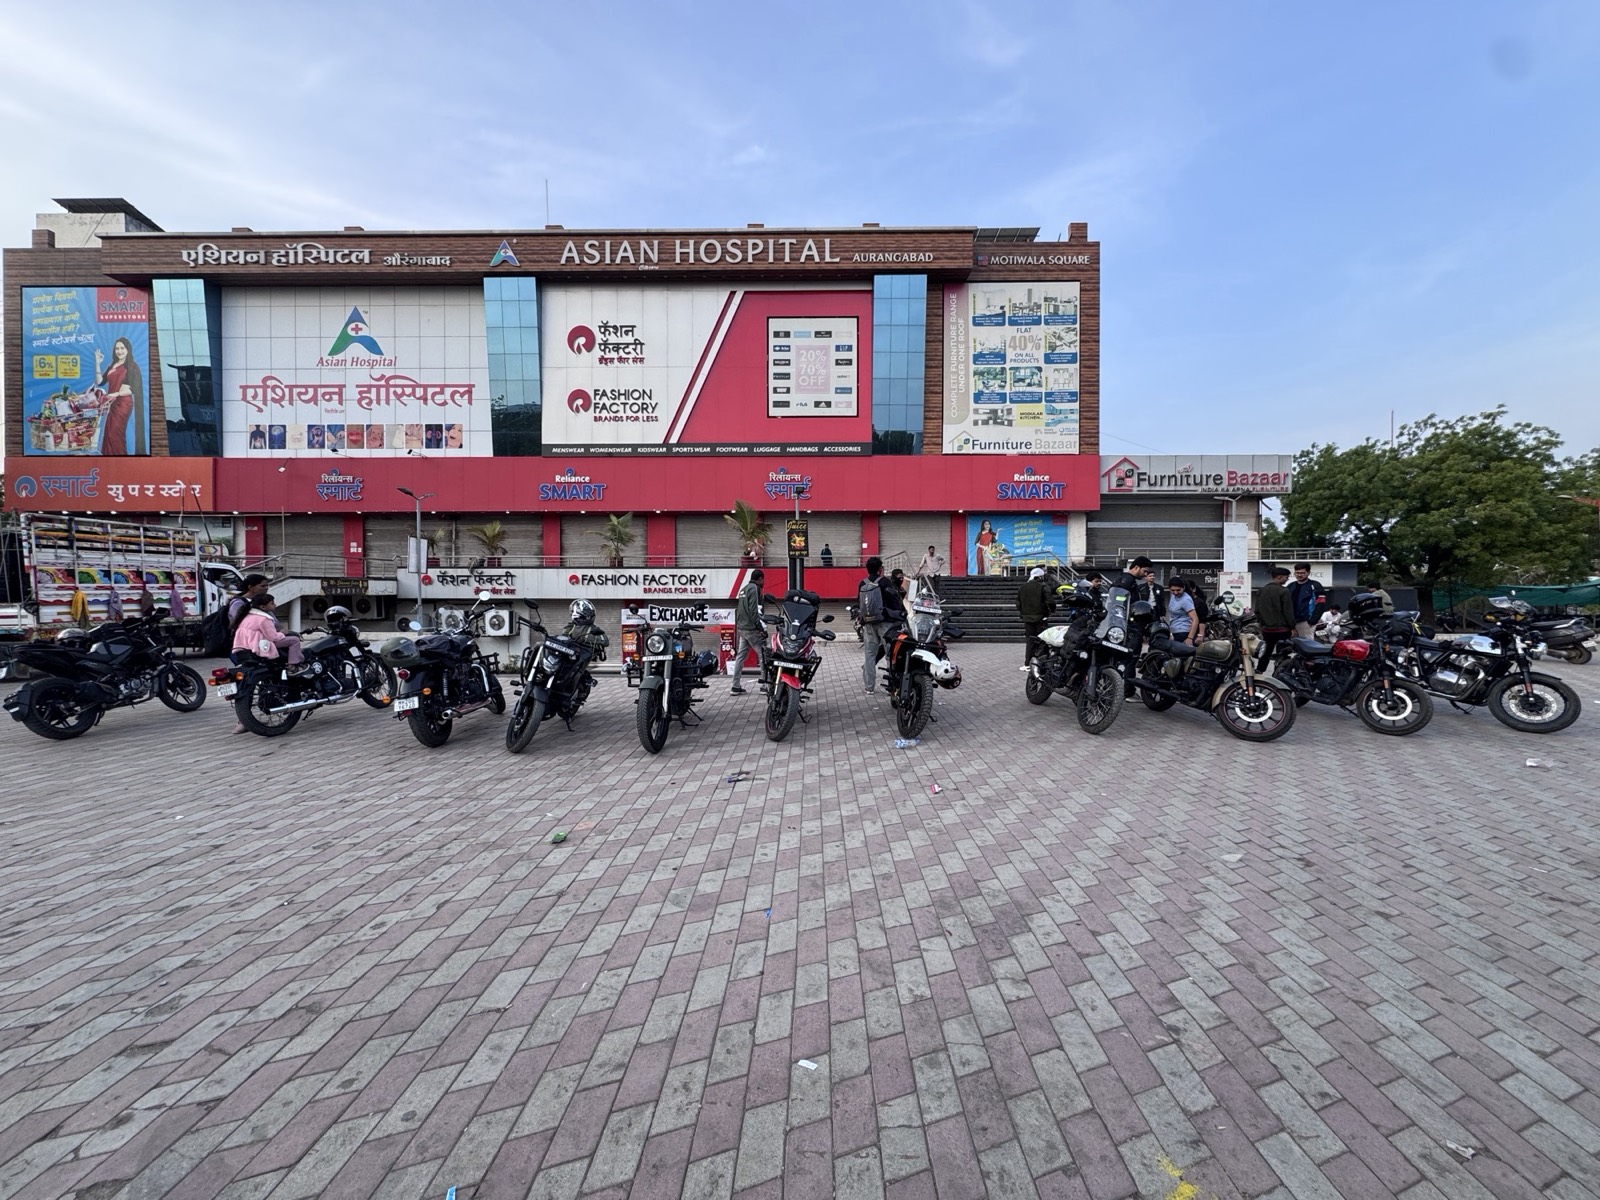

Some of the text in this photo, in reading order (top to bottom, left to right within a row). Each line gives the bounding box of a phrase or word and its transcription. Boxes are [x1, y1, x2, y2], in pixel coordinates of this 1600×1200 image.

[181, 242, 452, 267] एशियन हॉस्पिटल औरंगाबाद
[560, 238, 934, 264] ASIAN HOSPITAL AURANGABAD
[990, 255, 1090, 265] MOTIWALA SQUARE
[100, 301, 145, 313] SMART
[598, 320, 637, 338] फॅशन
[598, 338, 645, 356] फॅक्टरी
[1008, 335, 1041, 351] 40%
[316, 356, 398, 369] Asian Hospital
[799, 350, 826, 362] 20%
[949, 293, 958, 418] COMPLETE FURNITURE RANGE
[799, 364, 826, 376] 70%
[798, 376, 825, 386] OFF
[239, 373, 476, 413] एशियन हॉस्पिटल
[593, 389, 652, 401] FASHION
[593, 402, 658, 414] FACTORY
[971, 438, 1078, 450] Furniture Bazaar
[40, 467, 100, 498] स्मार्ट
[321, 473, 353, 483] रिलायन्स
[555, 475, 590, 483] Reliance
[769, 471, 801, 481] रिलायन्स
[1013, 473, 1050, 482] Reliance
[1136, 470, 1289, 487] Furniture Bazaar
[315, 477, 363, 501] स्मार्ट
[539, 483, 607, 501] SMART
[997, 482, 1066, 500] SMART
[437, 570, 516, 586] फॅशन फॅक्टरी
[581, 574, 707, 586] FASHION FACTORY
[649, 604, 709, 623] EXCHANGE
